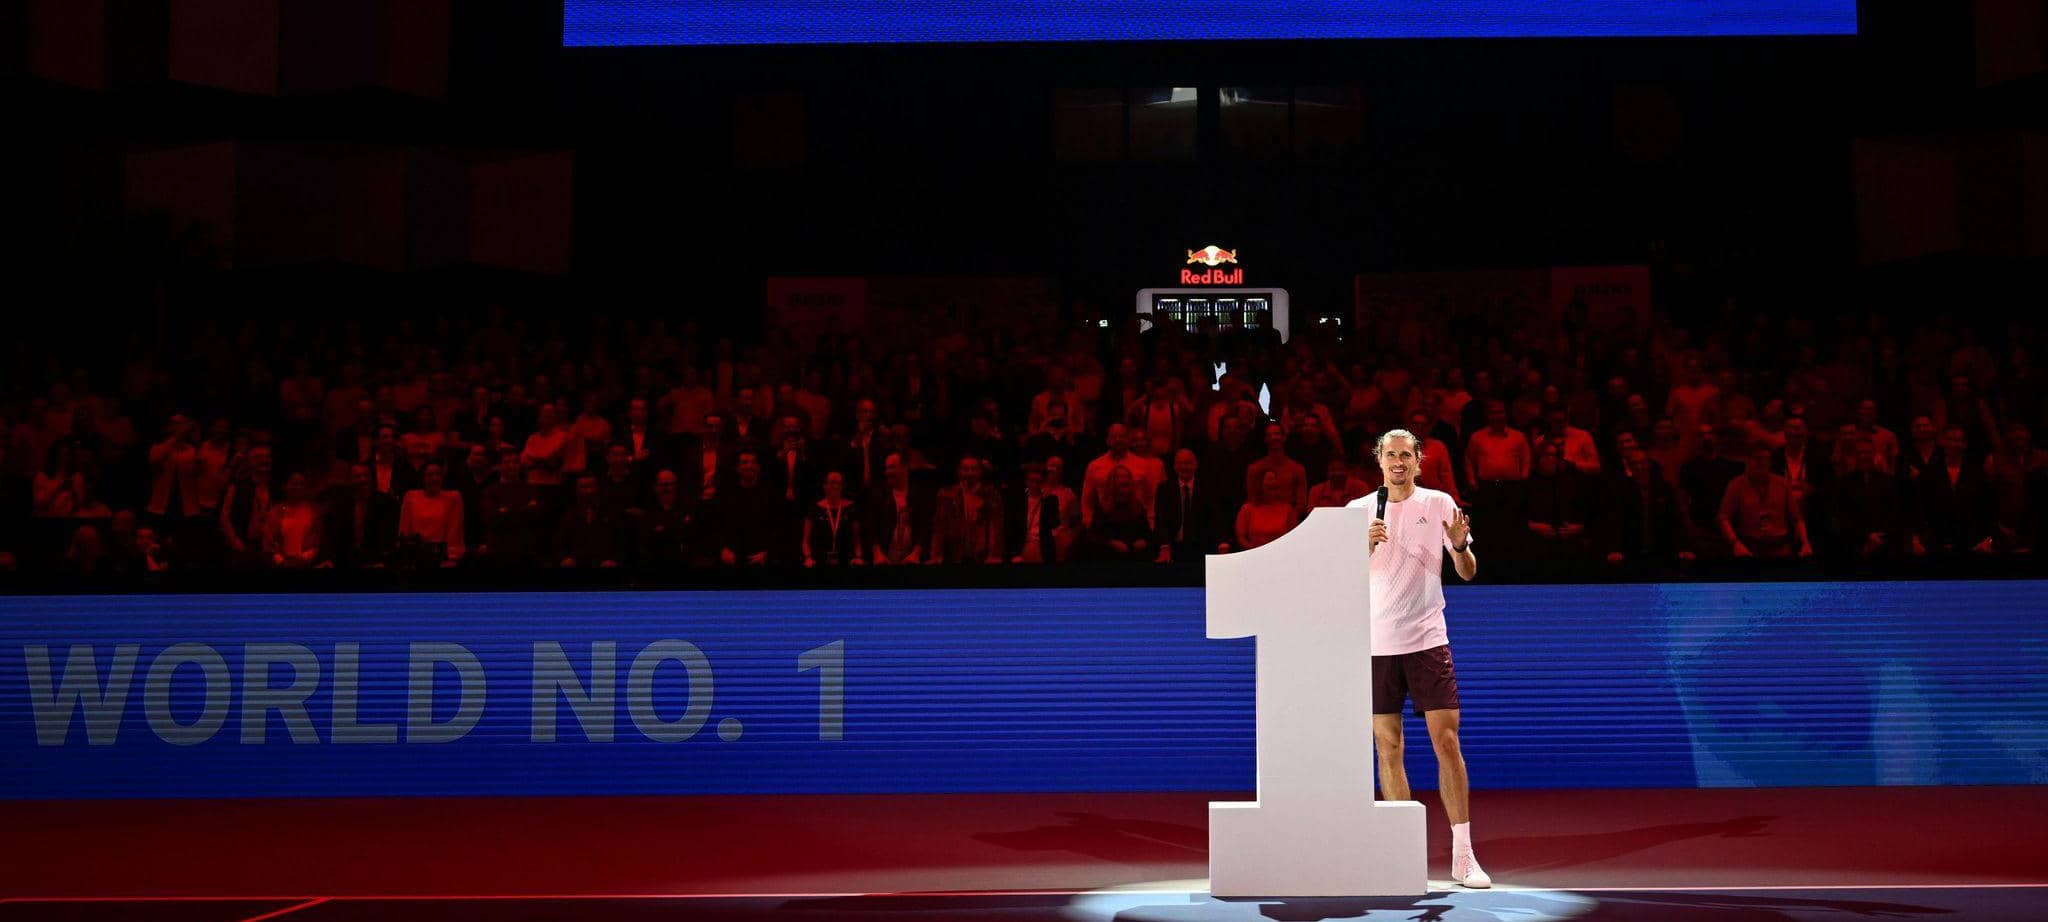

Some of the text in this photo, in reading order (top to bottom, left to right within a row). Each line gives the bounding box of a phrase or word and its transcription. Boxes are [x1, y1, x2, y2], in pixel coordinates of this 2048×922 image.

[1181, 269, 1243, 285] Red Bull
[24, 639, 845, 745] WORLD NO. 1
[1205, 507, 1427, 896] 1
